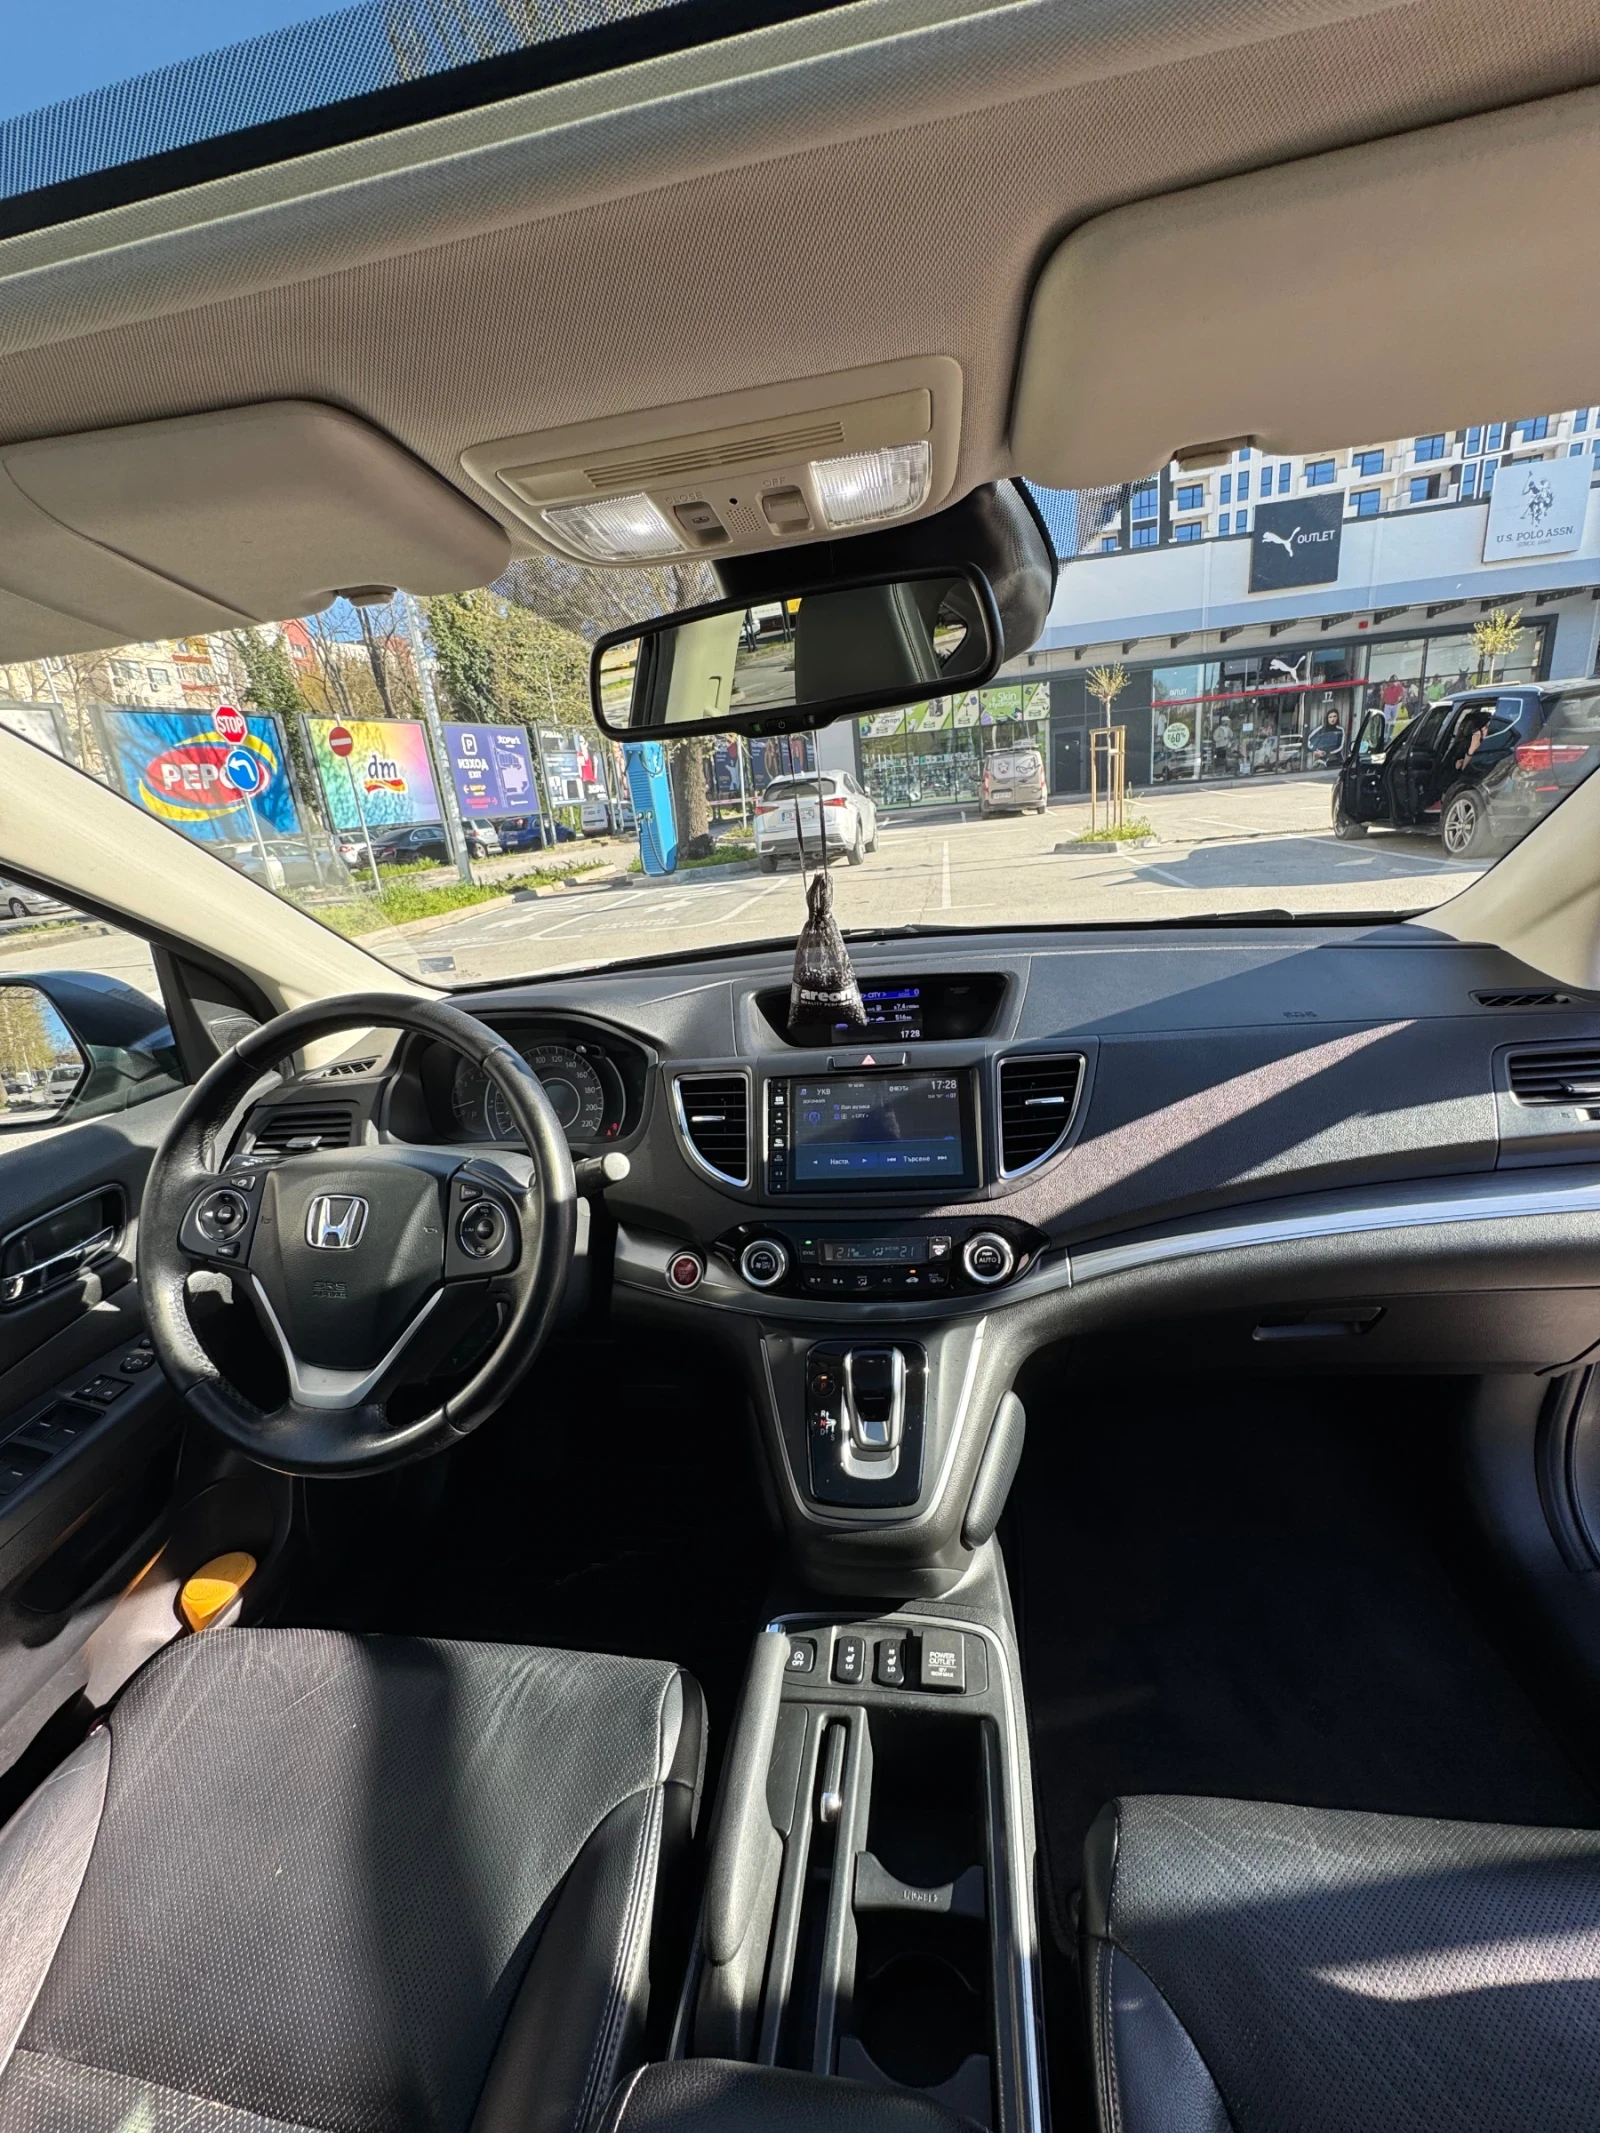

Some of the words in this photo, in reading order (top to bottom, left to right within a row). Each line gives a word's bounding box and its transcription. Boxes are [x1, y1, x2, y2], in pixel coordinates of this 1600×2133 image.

[763, 477, 786, 488] OFF
[665, 492, 703, 505] CLOSE
[1297, 530, 1335, 544] OUTLET
[1496, 534, 1514, 543] U.S.
[1516, 530, 1544, 541] POLO
[997, 691, 1017, 701] Skin
[1170, 688, 1187, 696] OUTLET
[217, 716, 243, 734] STOP
[368, 755, 397, 778] dm
[457, 759, 489, 771] ИЗХОД
[468, 771, 482, 779] EXIT
[800, 988, 853, 1002] areon
[868, 991, 882, 999] CITY
[566, 1061, 577, 1069] 140
[931, 1080, 957, 1090] 17:28
[585, 1103, 597, 1111] 200
[903, 1155, 931, 1163] Търсене
[313, 1280, 348, 1291] SRS
[930, 1651, 955, 1659] POWER
[928, 1657, 956, 1666] OUTLET
